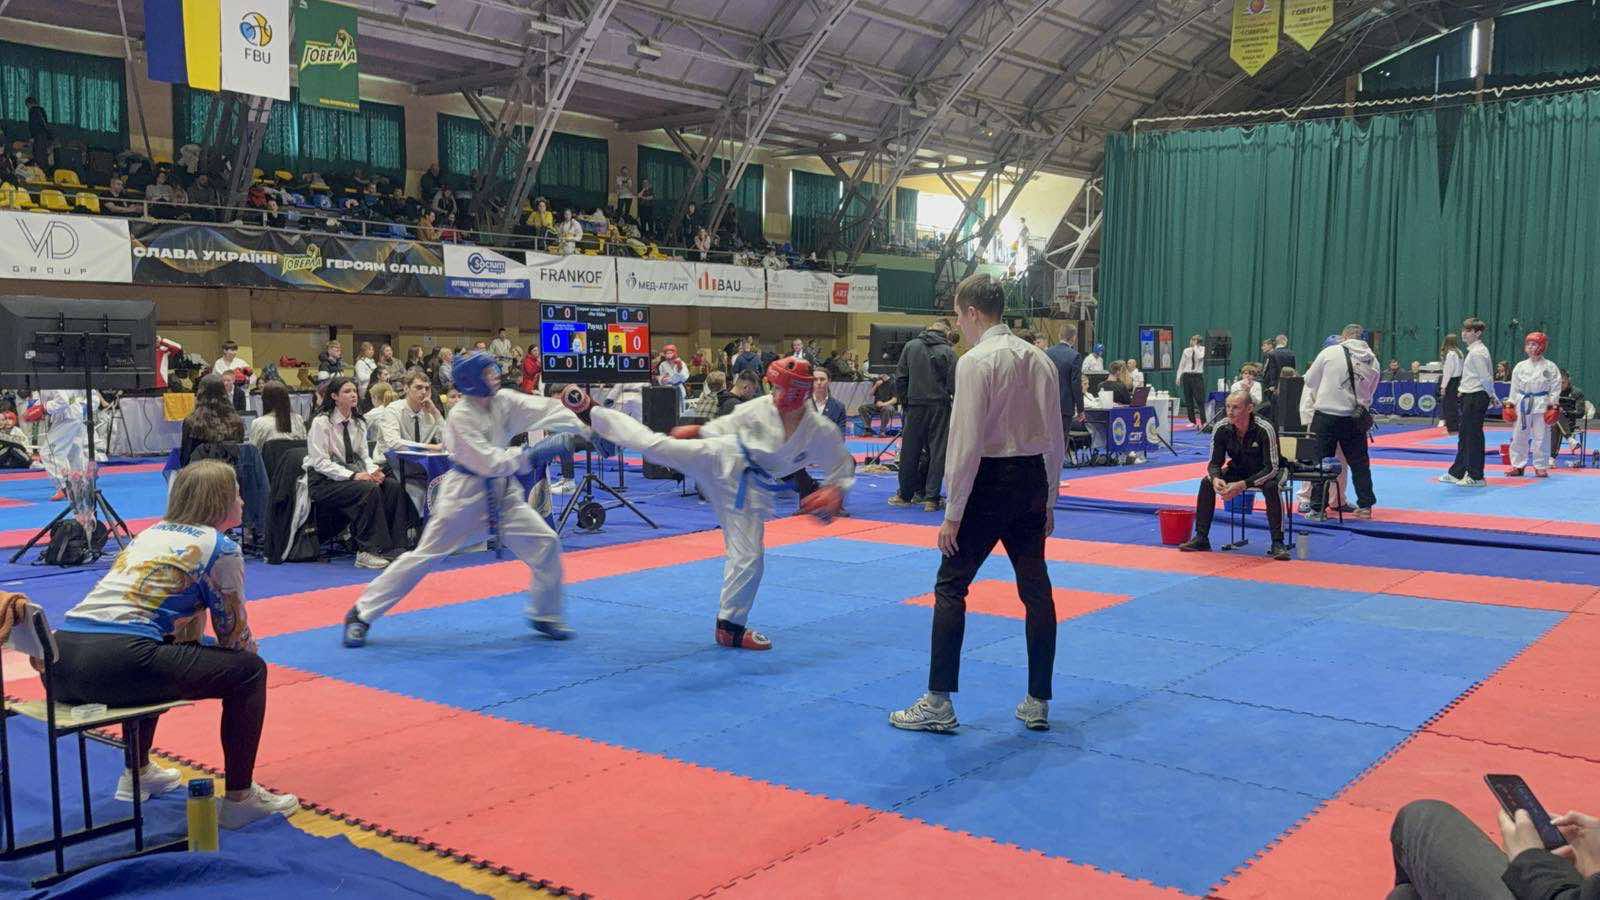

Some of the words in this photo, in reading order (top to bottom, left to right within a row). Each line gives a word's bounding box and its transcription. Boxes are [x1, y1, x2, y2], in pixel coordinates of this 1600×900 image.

[244, 48, 271, 64] FBU
[303, 46, 356, 63] ГОВЕРЛА
[133, 246, 198, 260] СЛАВА
[202, 249, 278, 264] УКРАЇНІ!
[12, 265, 87, 276] GROUP
[326, 258, 386, 272] ГЕРОЯМ
[389, 262, 443, 275] СЛАВА!
[540, 267, 602, 284] FRANKOF
[638, 280, 688, 291] МЕД-АТЛАНТ
[548, 307, 554, 318] 0
[622, 310, 628, 320] 0
[552, 334, 560, 349] 0
[633, 336, 641, 350] 0
[550, 357, 556, 368] 0
[582, 356, 615, 368] 1:14.4
[624, 358, 630, 368] 0
[1133, 411, 1141, 428] 2
